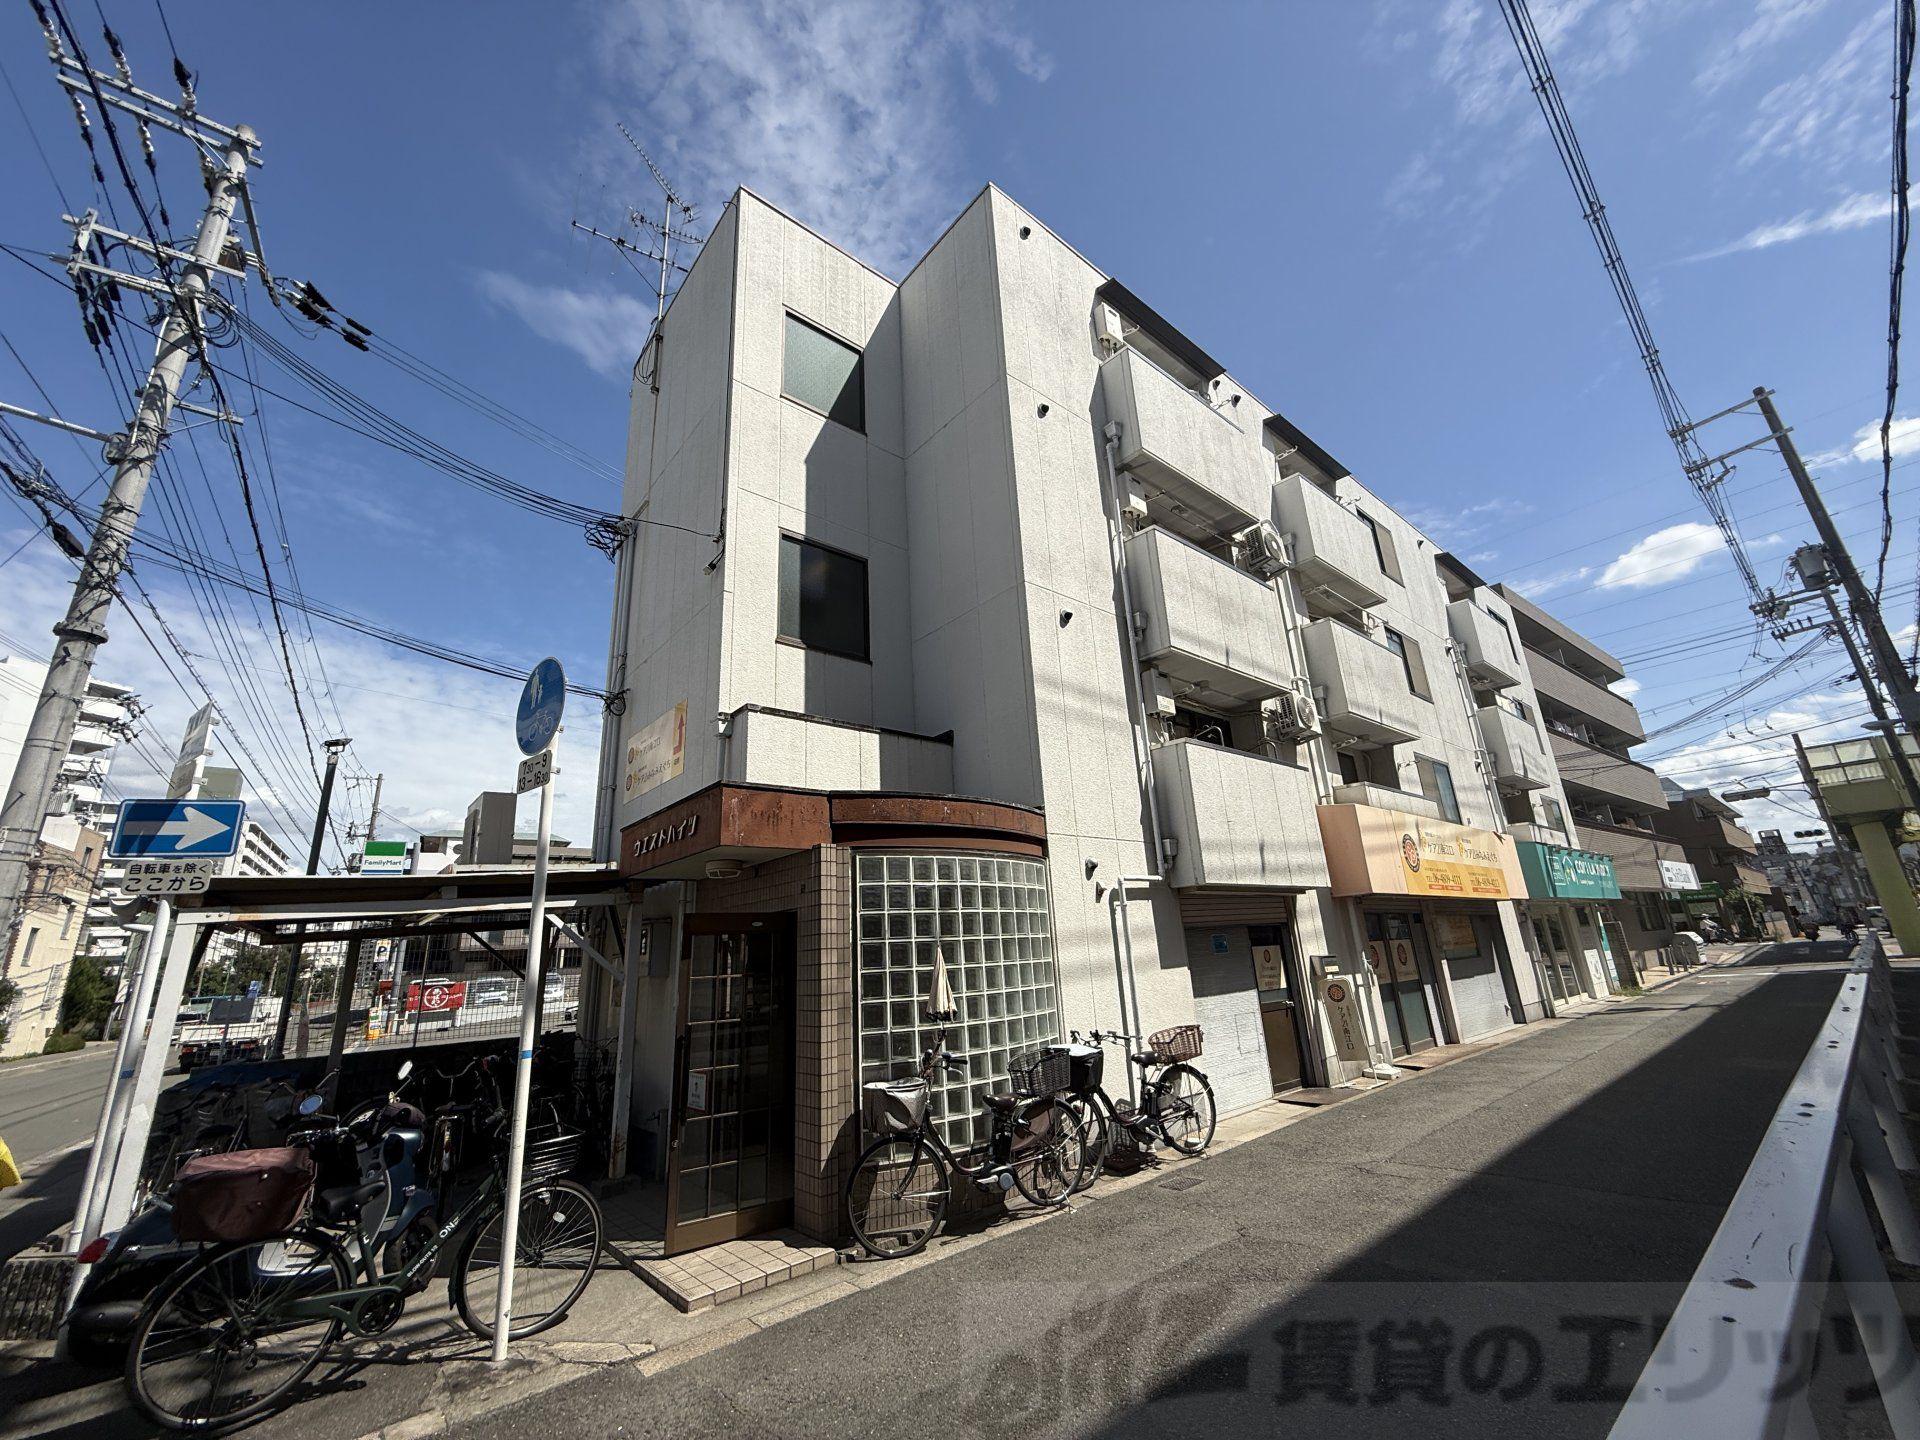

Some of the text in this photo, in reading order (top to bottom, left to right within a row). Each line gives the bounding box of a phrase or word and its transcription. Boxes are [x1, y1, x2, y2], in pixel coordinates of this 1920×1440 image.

[633, 815, 697, 857] ウエストハイツ
[129, 862, 208, 875] 自転車を除く
[124, 876, 206, 892] ここから
[377, 945, 387, 957] P
